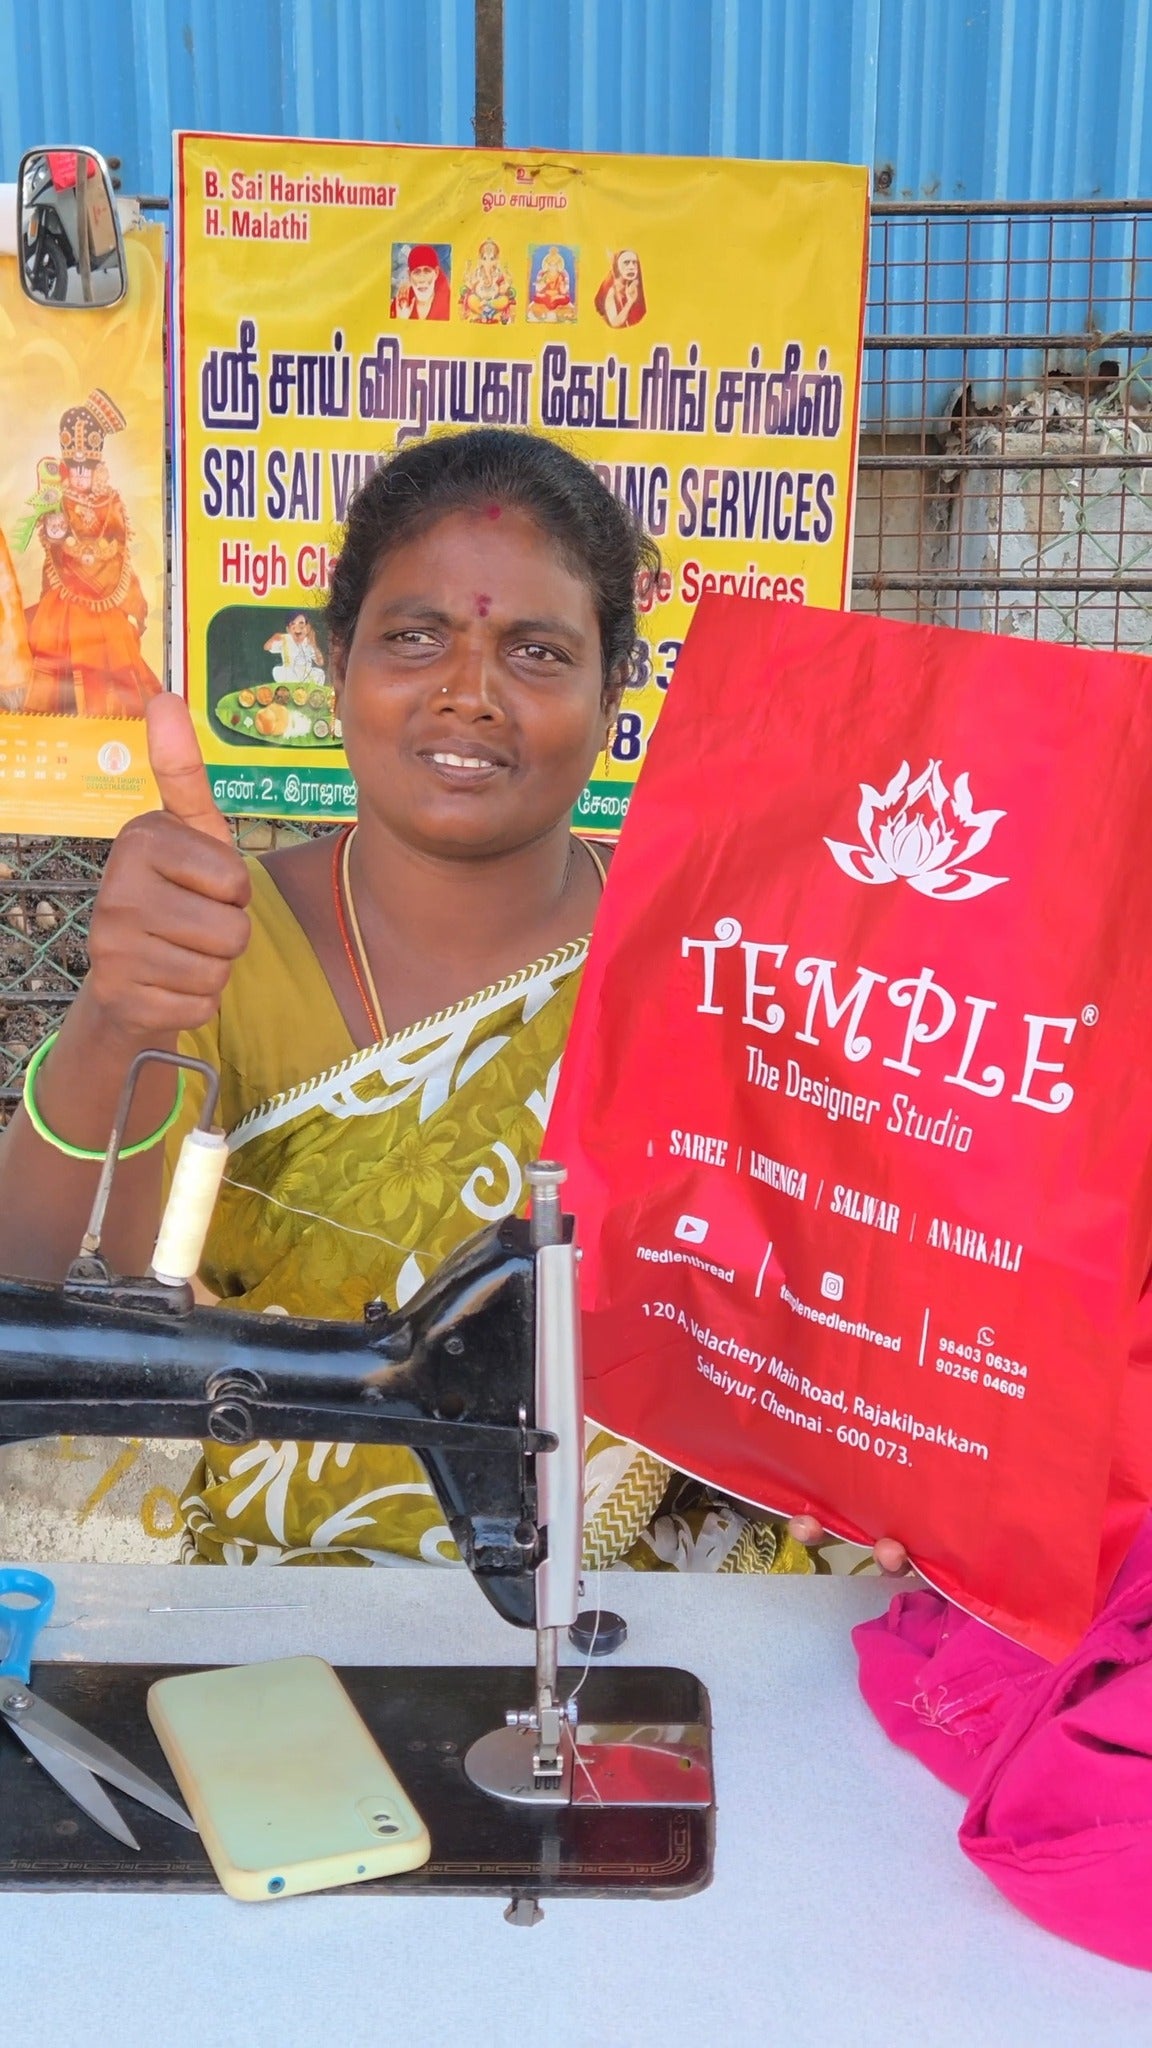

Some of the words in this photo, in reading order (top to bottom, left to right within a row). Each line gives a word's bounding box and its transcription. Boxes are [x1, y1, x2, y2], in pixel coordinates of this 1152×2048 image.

[205, 171, 224, 198] B.
[231, 172, 263, 200] Sai
[270, 174, 396, 207] Harishkumar
[206, 209, 225, 236] H.
[232, 210, 308, 240] Malathi
[269, 331, 350, 418] சாய்
[541, 344, 707, 433] கேட்டரிங்
[715, 343, 842, 437] சர்வீஸ்
[203, 448, 255, 518] SRI
[267, 450, 320, 521] SAI
[678, 467, 834, 543] SERVICES
[222, 542, 286, 597] High
[681, 916, 1078, 1115] TEMPLE
[745, 1044, 779, 1091] The
[786, 1059, 881, 1122] Designer
[887, 1092, 973, 1153] Studio
[669, 1129, 728, 1168] SAREE
[750, 1150, 809, 1200] LEHENGA
[830, 1184, 901, 1235] SALWAR
[926, 1217, 1023, 1273] ANARKALI
[636, 1246, 735, 1284] needlenthread
[690, 1318, 767, 1373] Velachery
[767, 1356, 800, 1391] Main
[800, 1376, 849, 1413] Road,
[853, 1396, 989, 1460] Rajakilpakkam
[935, 1358, 979, 1384] 90256
[982, 1373, 1026, 1399] 04609
[939, 1337, 982, 1363] 98403
[985, 1353, 1028, 1379] 06334
[696, 1354, 757, 1405] Selaiyur,
[760, 1389, 822, 1433] Chennai
[836, 1425, 870, 1451] 600
[873, 1437, 913, 1467] 073.
